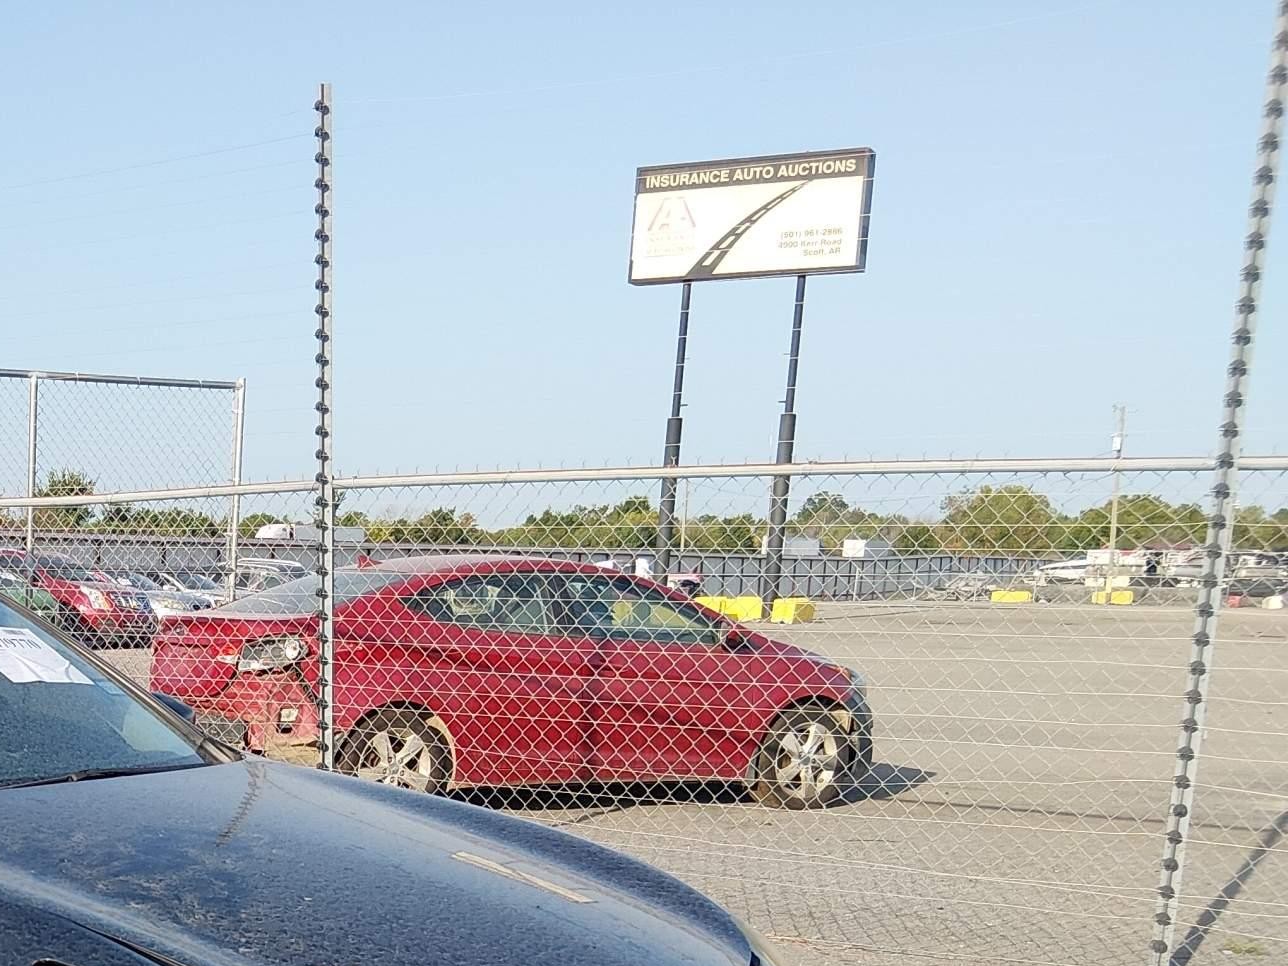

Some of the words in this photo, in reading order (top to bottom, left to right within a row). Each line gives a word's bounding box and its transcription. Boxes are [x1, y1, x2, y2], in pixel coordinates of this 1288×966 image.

[645, 170, 730, 189] INSURANCE
[732, 165, 774, 181] AUTO
[777, 158, 857, 178] AUCTIONS
[820, 238, 842, 247] Road
